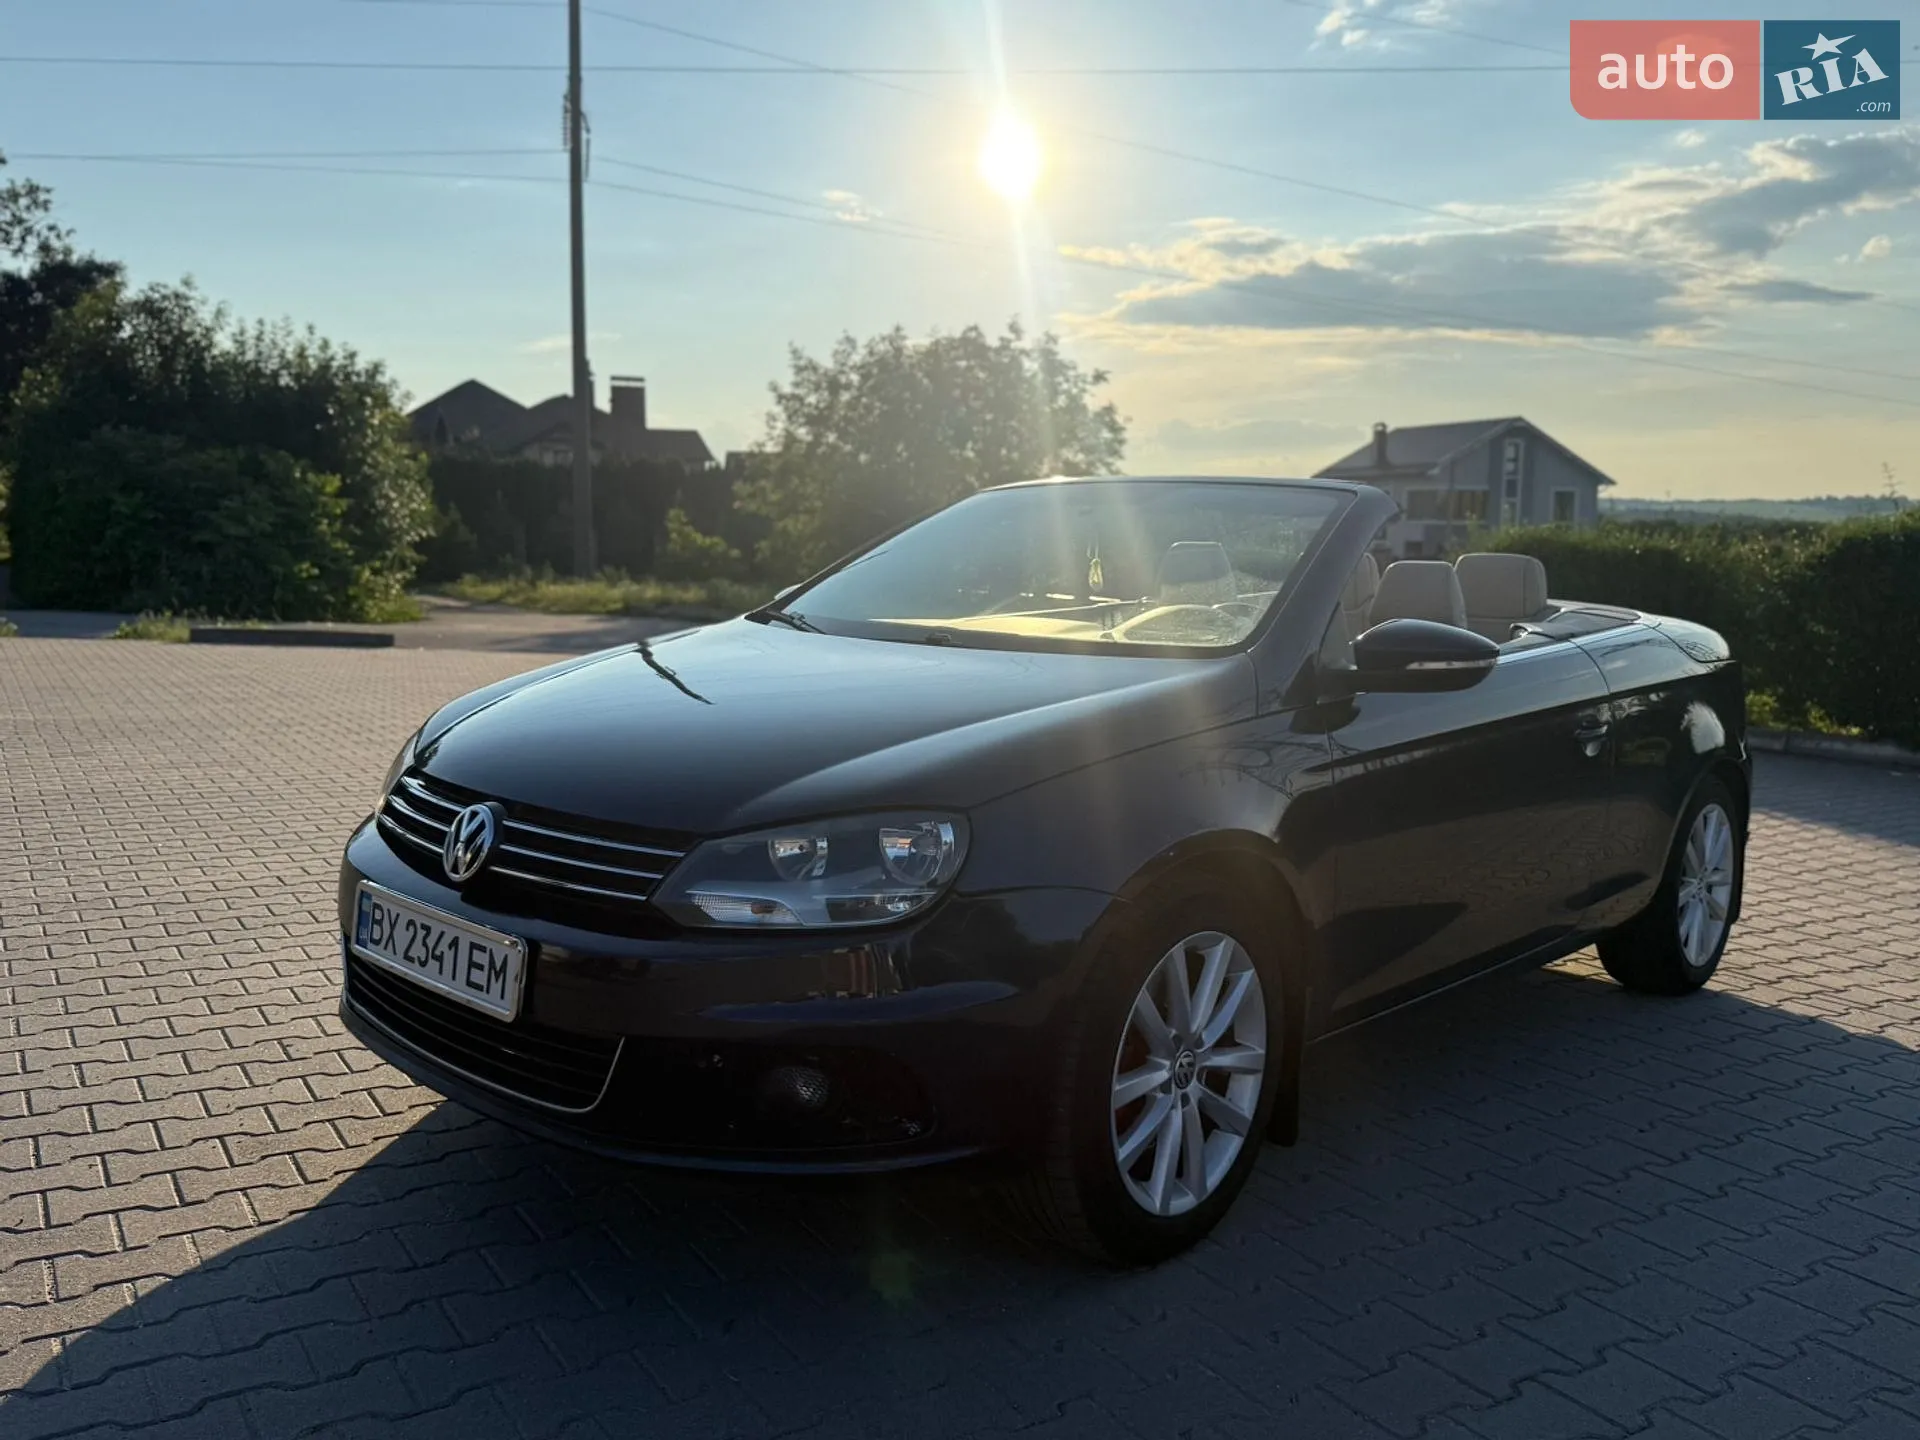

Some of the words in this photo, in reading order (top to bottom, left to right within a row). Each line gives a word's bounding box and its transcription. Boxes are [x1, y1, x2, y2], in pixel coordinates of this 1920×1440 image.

[369, 902, 400, 955] BX
[403, 918, 460, 981] 2341
[465, 940, 508, 1000] EM
